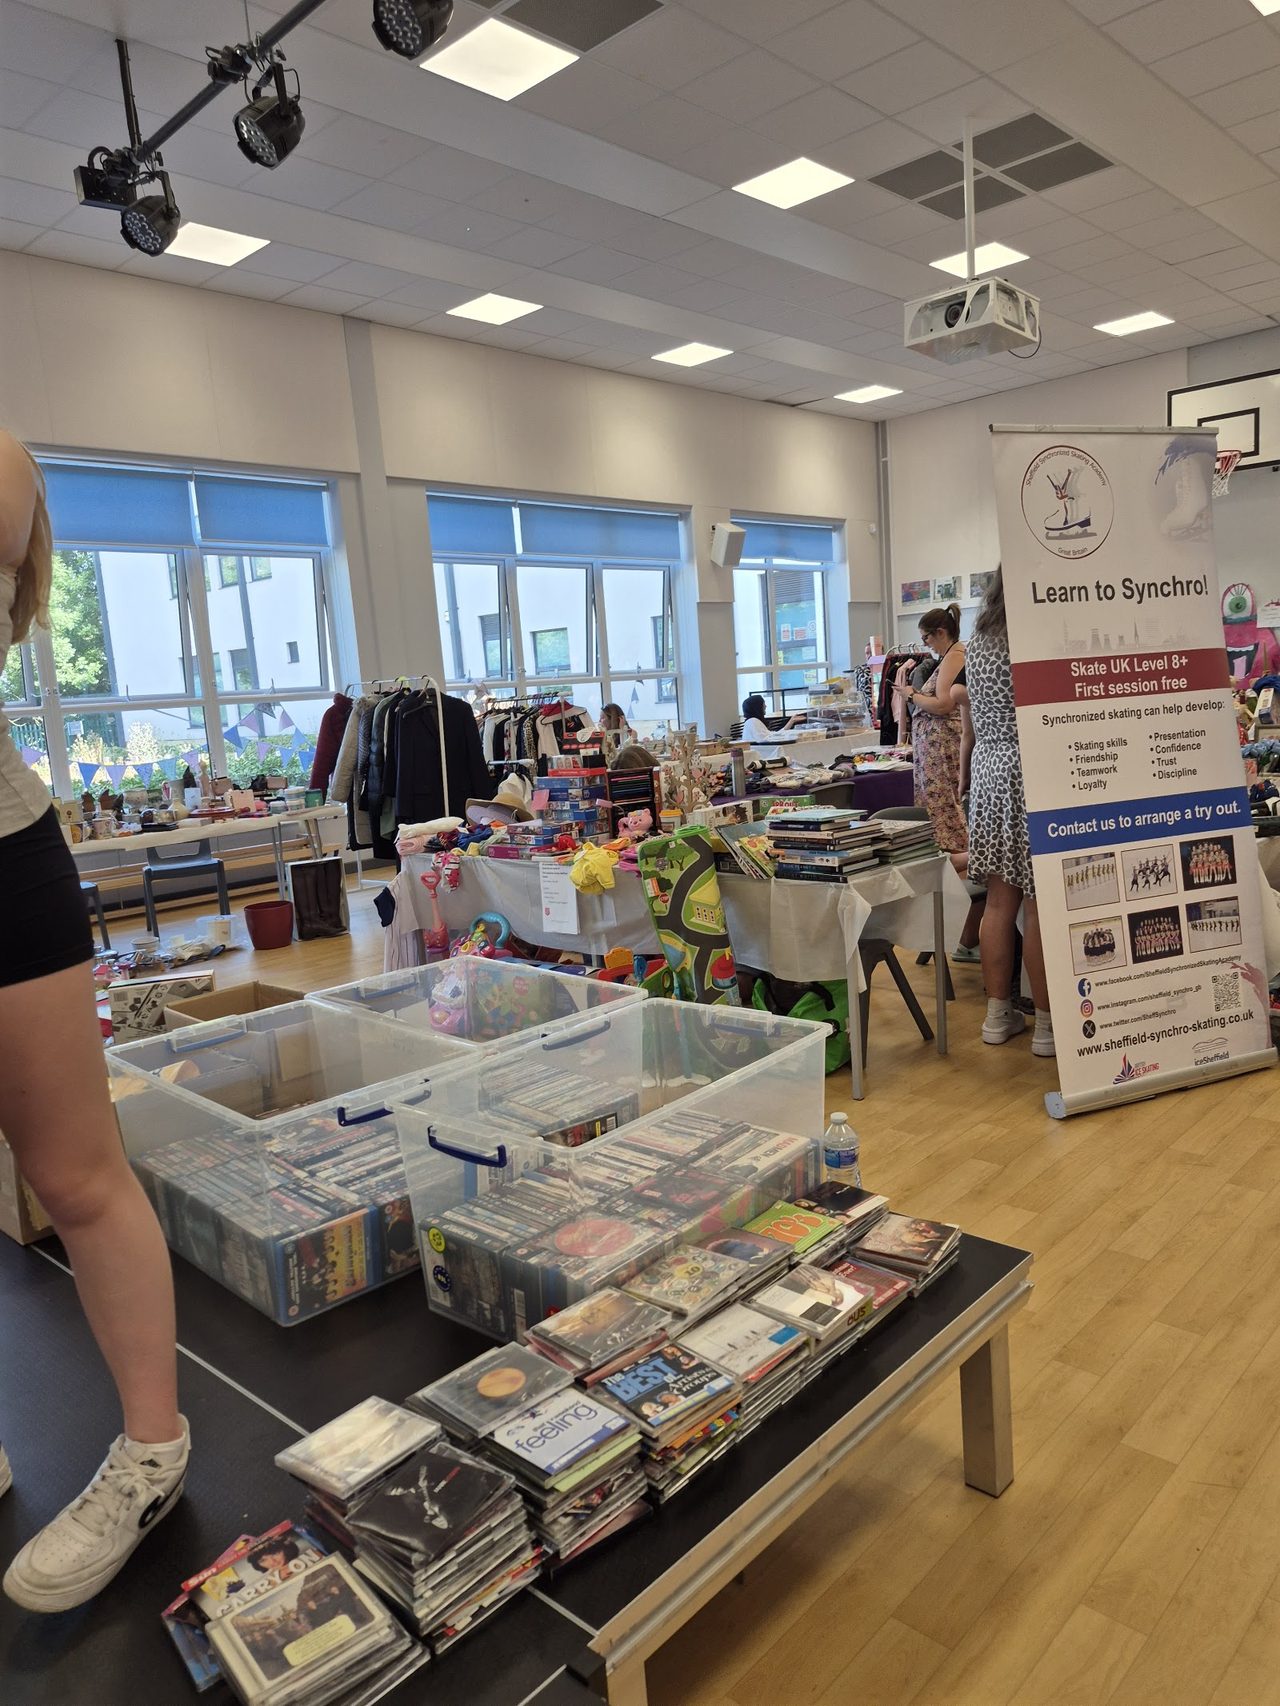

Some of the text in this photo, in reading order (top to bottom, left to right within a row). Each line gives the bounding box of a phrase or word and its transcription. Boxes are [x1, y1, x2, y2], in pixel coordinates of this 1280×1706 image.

[1031, 574, 1209, 605] Learn to Synchro!
[1070, 654, 1188, 677] Skate UK Level 8+
[1075, 676, 1187, 698] First session free
[1042, 700, 1226, 726] Synchronized skating can help develop:
[1154, 728, 1206, 741] Presentation
[1074, 737, 1128, 752] Skating skills
[1155, 741, 1201, 754] Confidence
[1075, 752, 1118, 765] Friendship
[1156, 757, 1177, 767] Trust
[1076, 764, 1118, 777] Teamwork
[1158, 767, 1197, 780] Discipline
[1078, 779, 1107, 791] Loyalty
[1047, 801, 1241, 838] Contact us to arrange a try out.
[1077, 1009, 1254, 1057] www.sheffield-synchro-skating.co.uk
[601, 1372, 625, 1386] The
[607, 1356, 677, 1402] BEST
[515, 1404, 598, 1453] feeling
[218, 1569, 283, 1616] CARRY
[287, 1548, 323, 1574] ON
